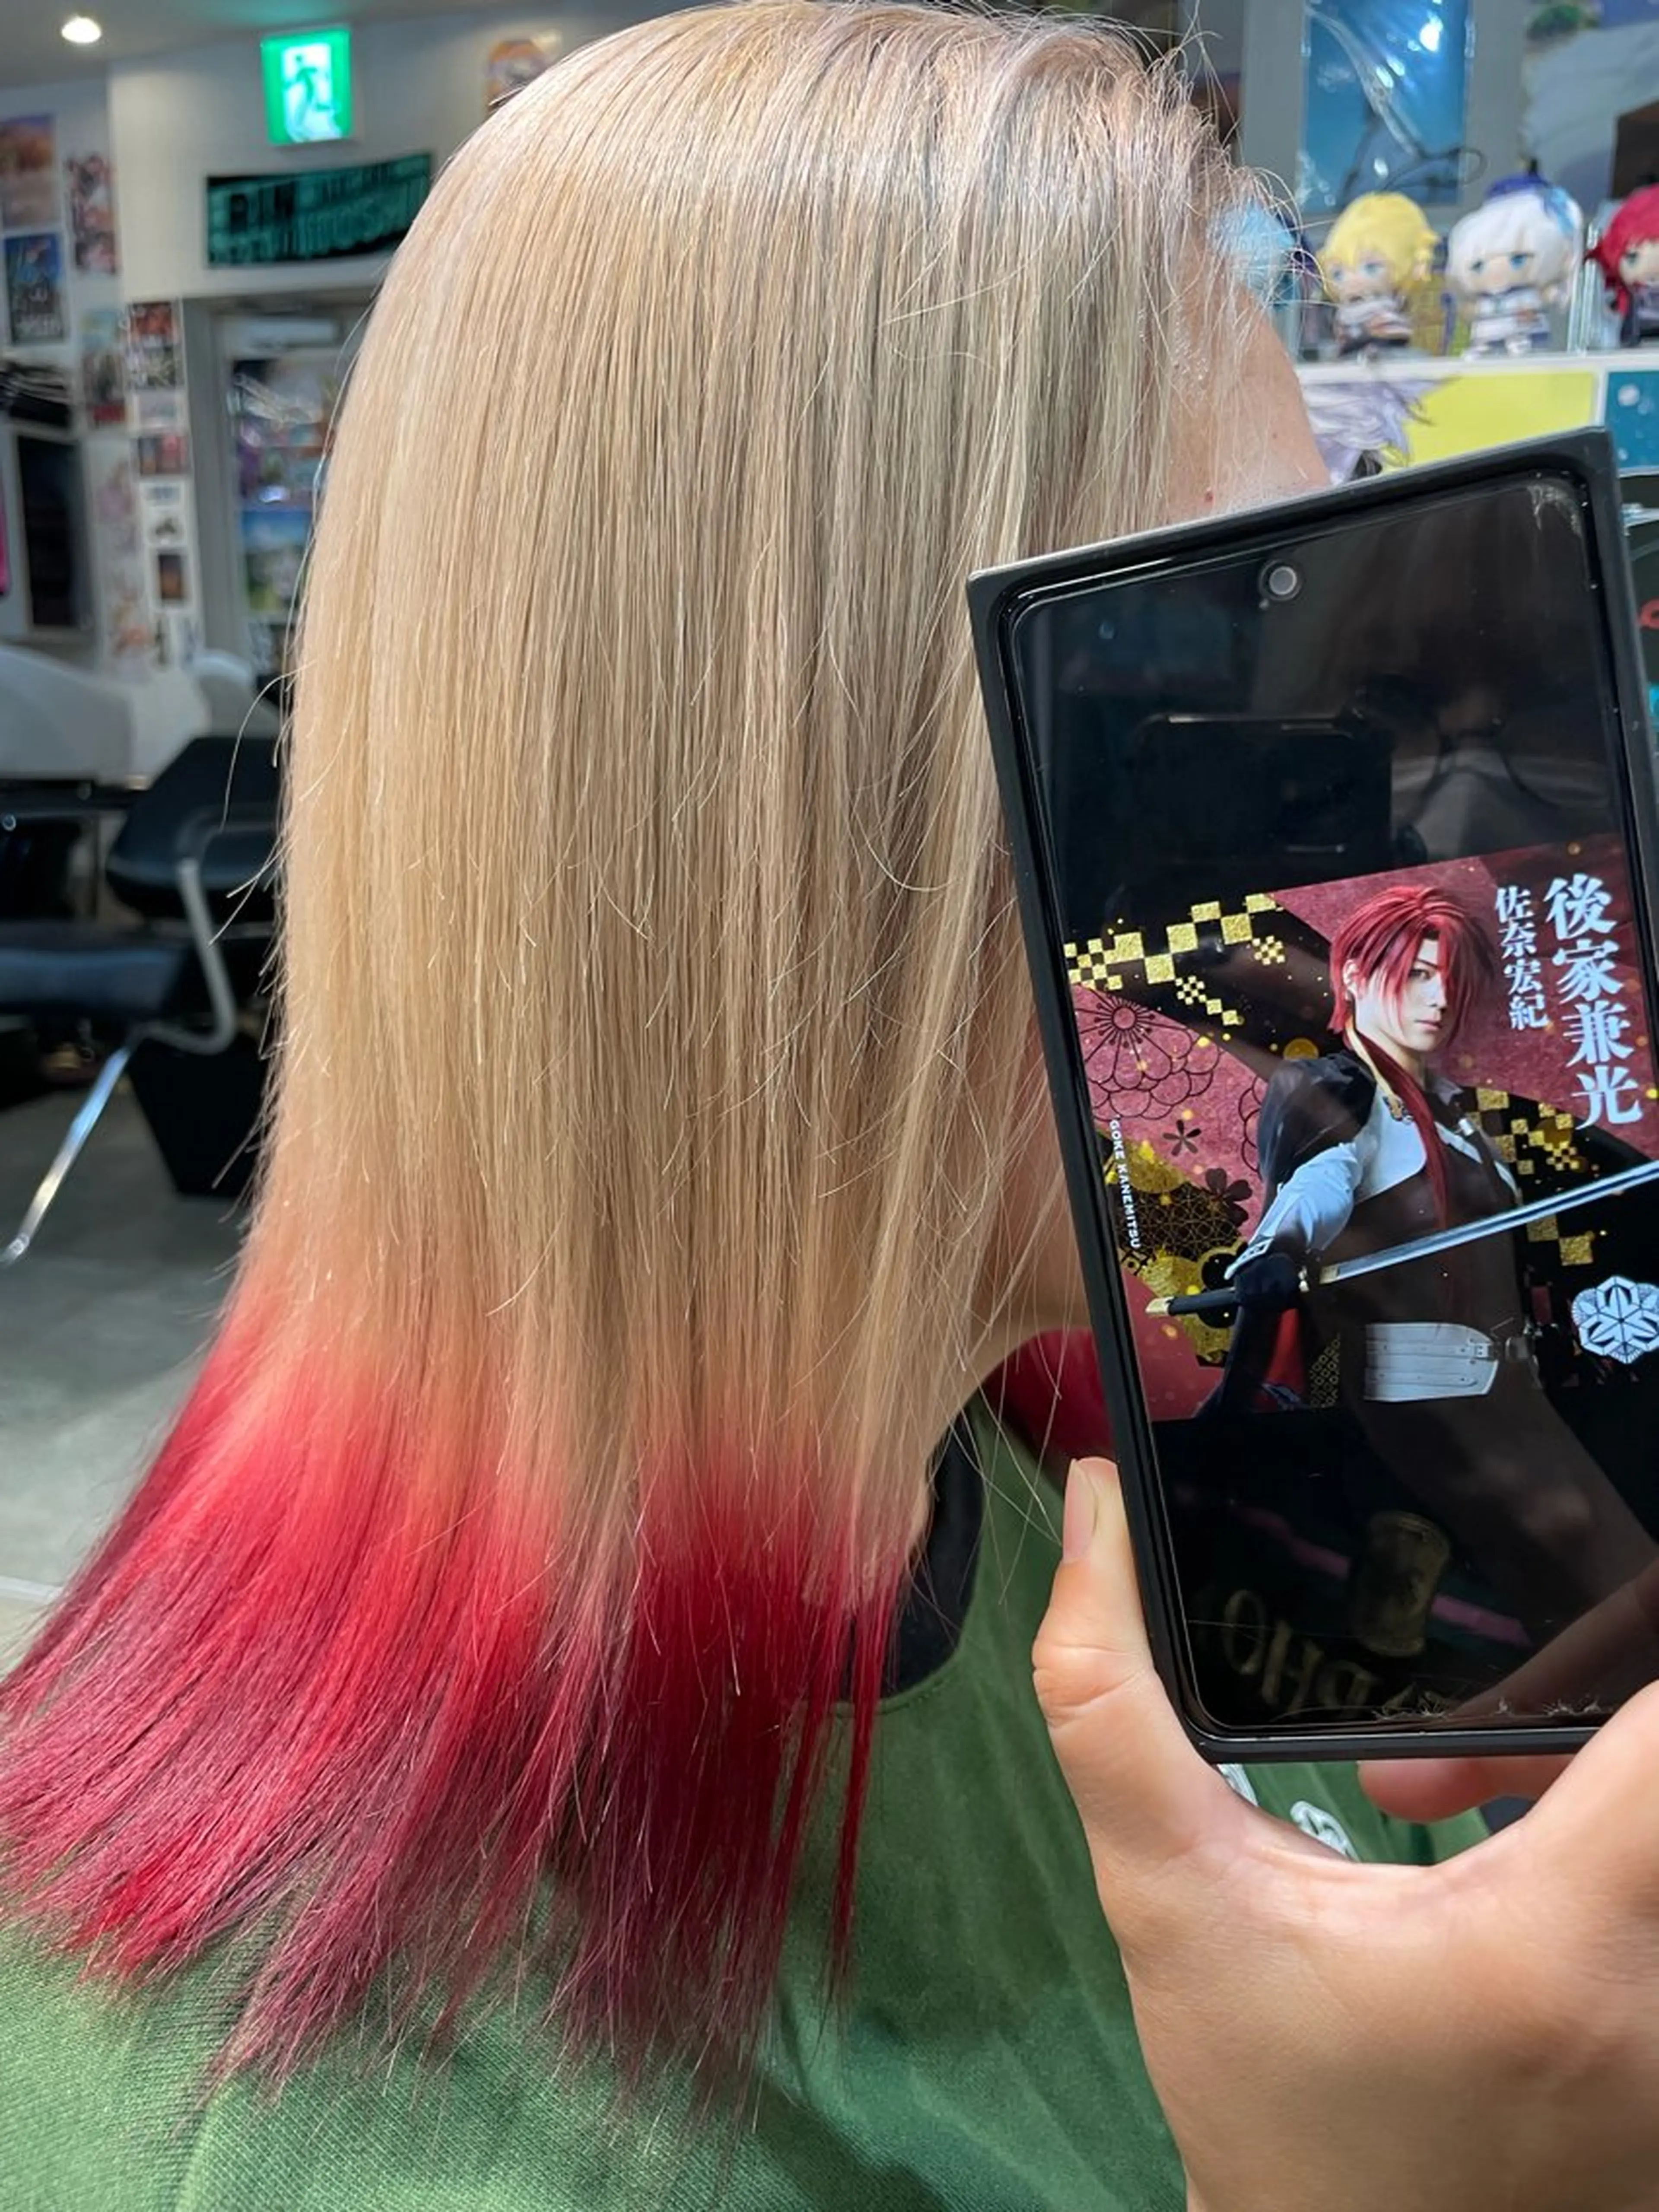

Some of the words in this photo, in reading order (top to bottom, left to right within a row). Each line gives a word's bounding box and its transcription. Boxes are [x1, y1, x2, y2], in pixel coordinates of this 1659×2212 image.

[1494, 885, 1550, 1031] 佐奈宏紀
[1544, 872, 1643, 1130] 後家兼光
[1109, 1119, 1125, 1160] GOKE
[1118, 1164, 1141, 1249] KANEMITSU
